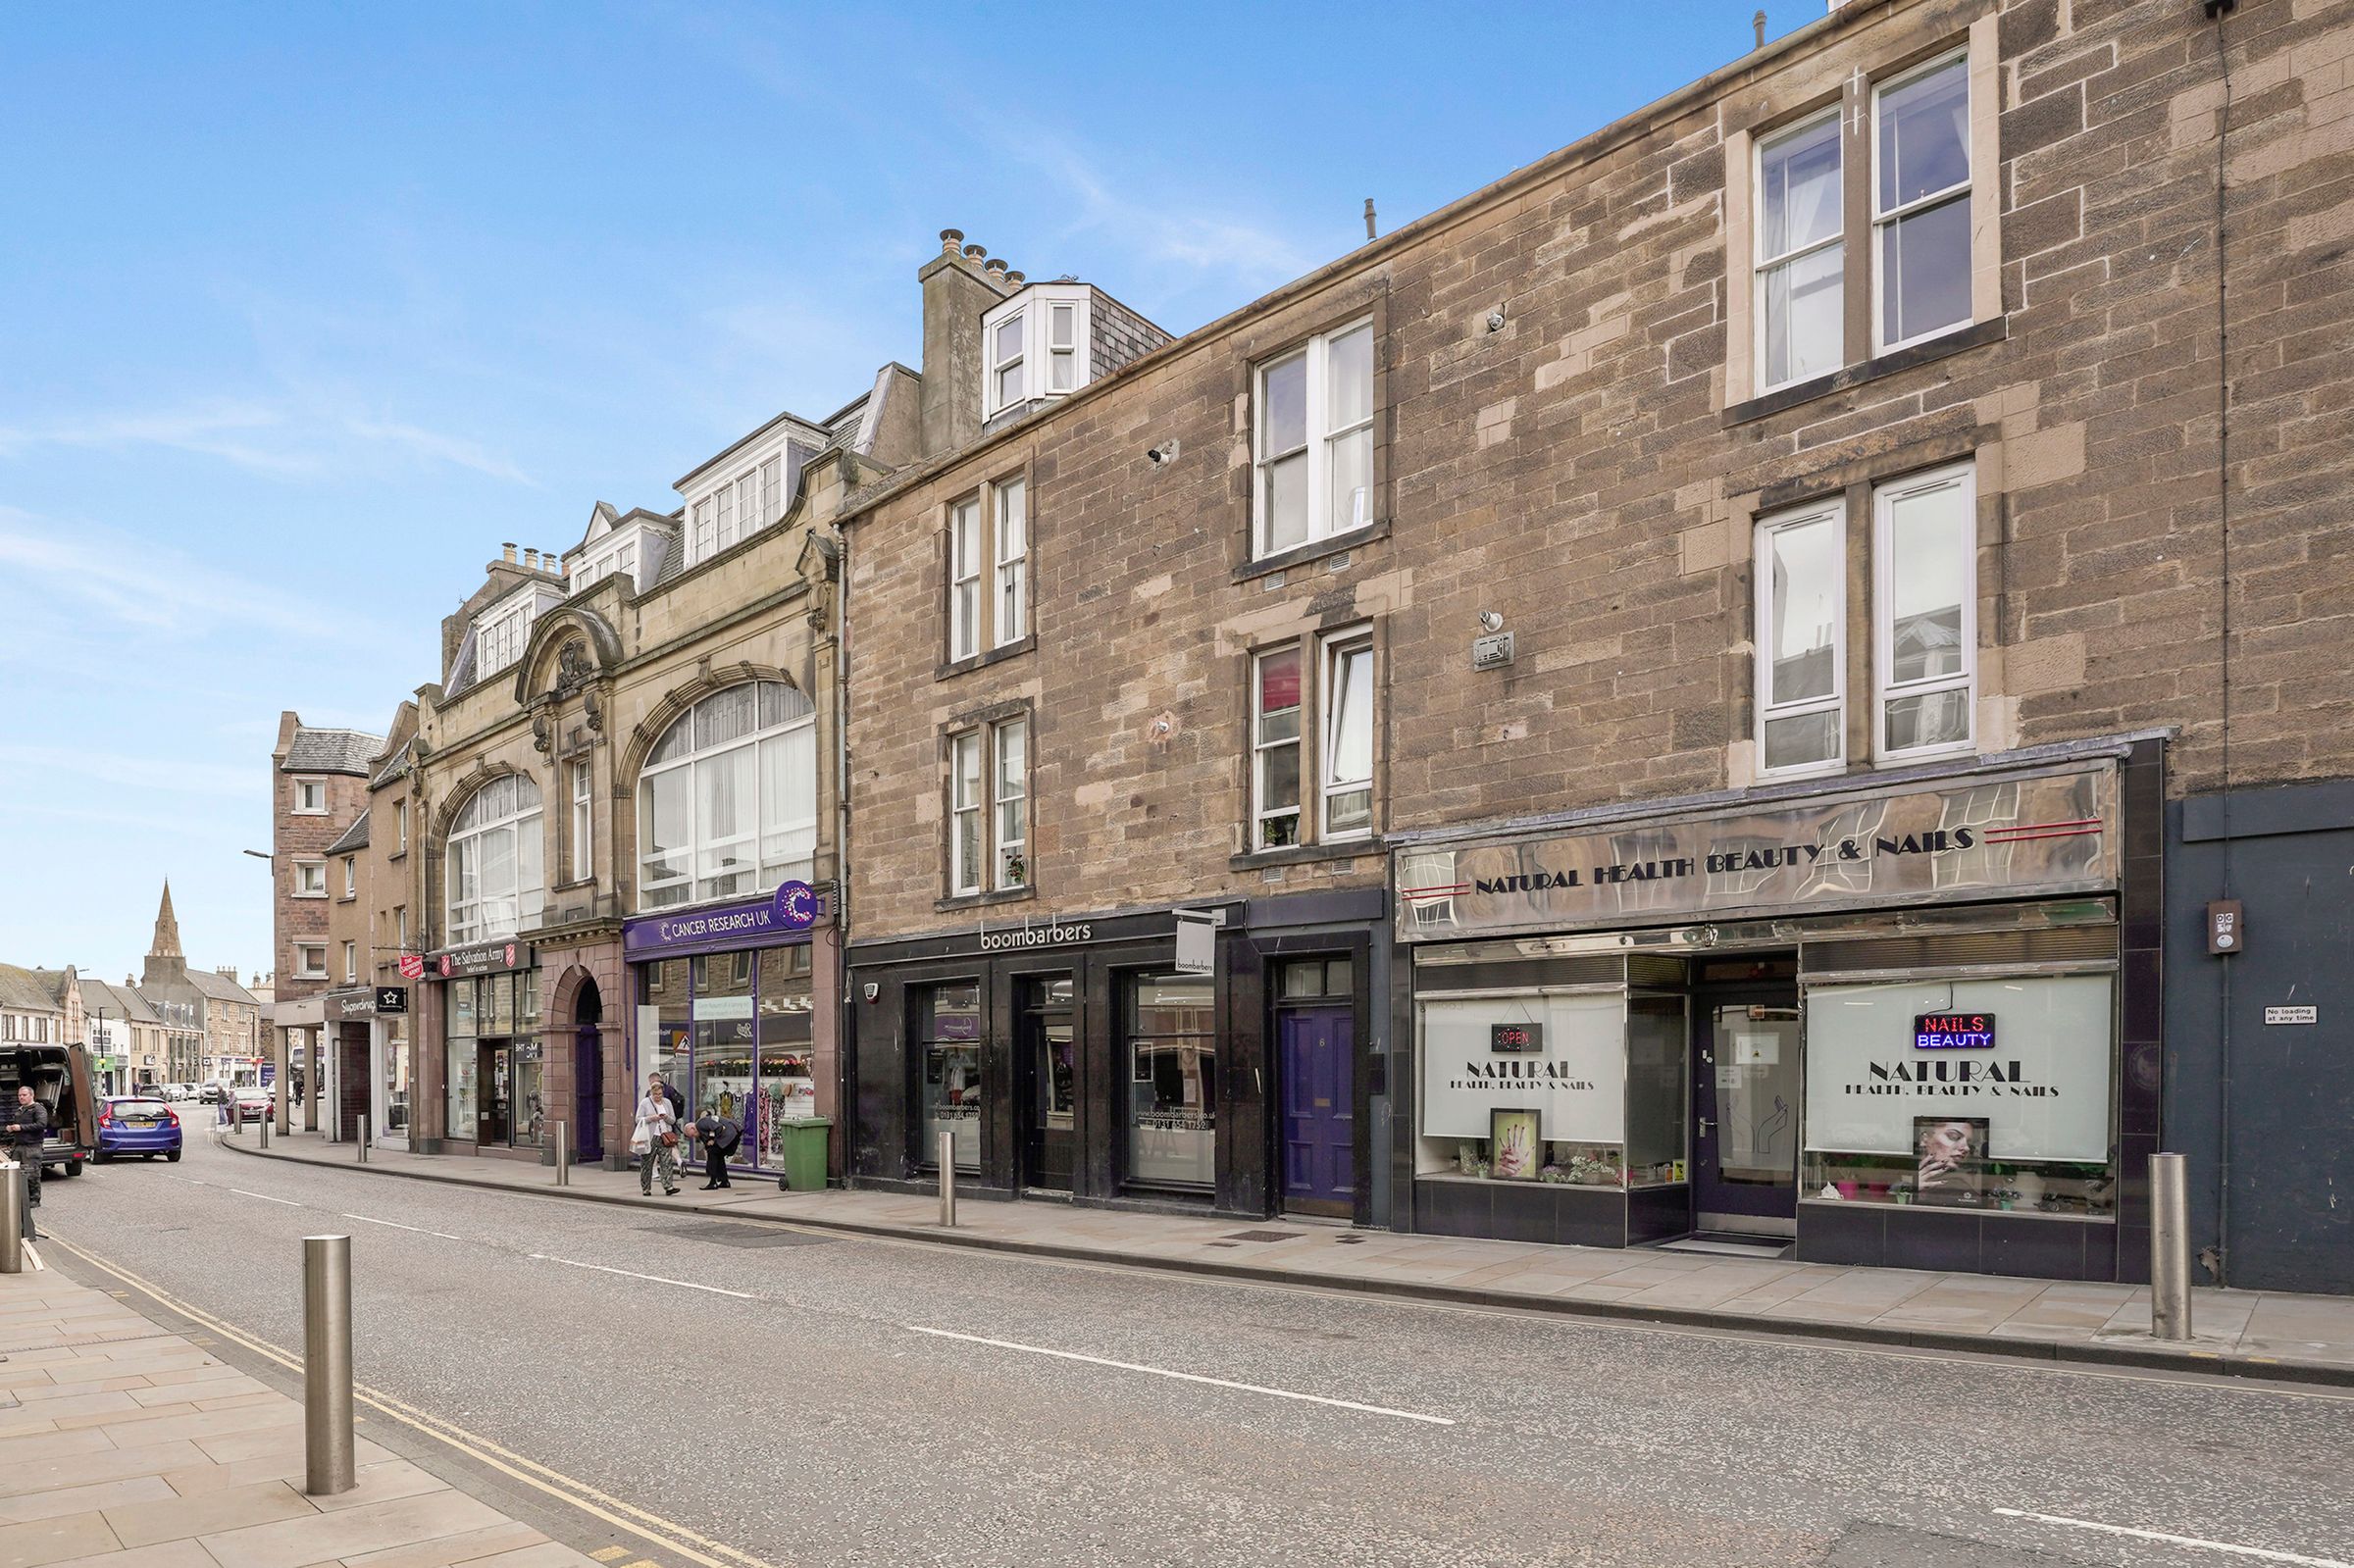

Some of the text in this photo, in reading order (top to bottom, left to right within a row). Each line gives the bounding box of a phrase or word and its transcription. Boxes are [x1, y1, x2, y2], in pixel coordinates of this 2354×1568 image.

[1476, 828, 1974, 895] NATURAL HEALTH BEAUTY & NAILS
[672, 910, 771, 937] CANCER RESEARCH UK
[981, 912, 1092, 950] boombarbers
[451, 948, 505, 967] The Salvation Army
[1178, 957, 1213, 971] boombarbers
[341, 998, 376, 1015] Superdrug
[1925, 1017, 1984, 1033] NAILS
[1502, 1032, 1529, 1044] OPEN
[1918, 1034, 1991, 1047] BEAUTY
[1467, 1061, 1575, 1079] NATURAL
[1869, 1061, 2030, 1083] NATURAL
[1500, 1081, 1543, 1089] BEAUTY
[1549, 1081, 1556, 1089] &
[1917, 1085, 1983, 1096] BEAUTY
[1990, 1086, 2002, 1096] &
[2010, 1087, 2060, 1097] NAILS
